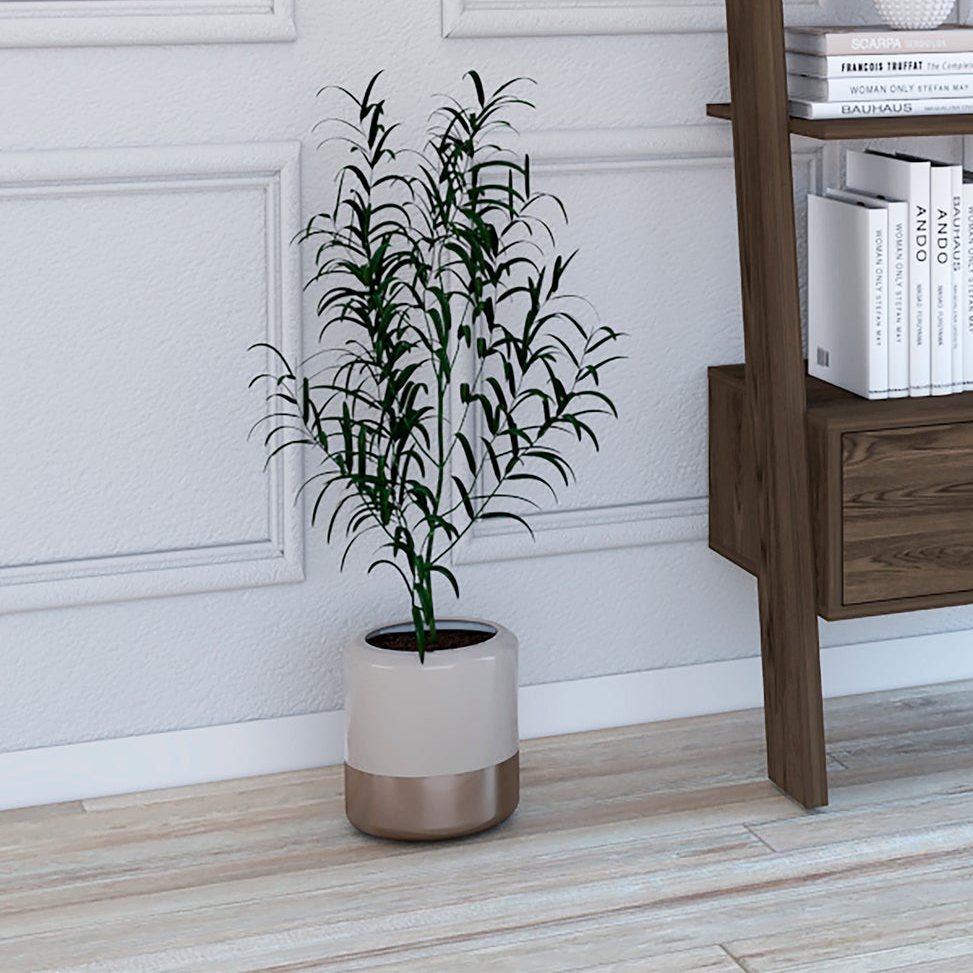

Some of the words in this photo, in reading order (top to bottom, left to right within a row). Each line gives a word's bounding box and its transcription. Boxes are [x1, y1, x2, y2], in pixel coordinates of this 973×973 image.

[851, 38, 902, 50] SCARPA
[927, 61, 940, 70] The
[849, 85, 887, 94] WOMAN
[889, 84, 915, 93] ONLY
[841, 104, 913, 114] BAUHAUS
[895, 223, 903, 260] WOMAN
[915, 204, 927, 263] ANDO
[937, 208, 948, 265] ANDO
[953, 196, 961, 272] BAUHAUS
[874, 229, 883, 265] WOMAN
[875, 268, 883, 292] ONLY
[895, 262, 903, 287] ONLY
